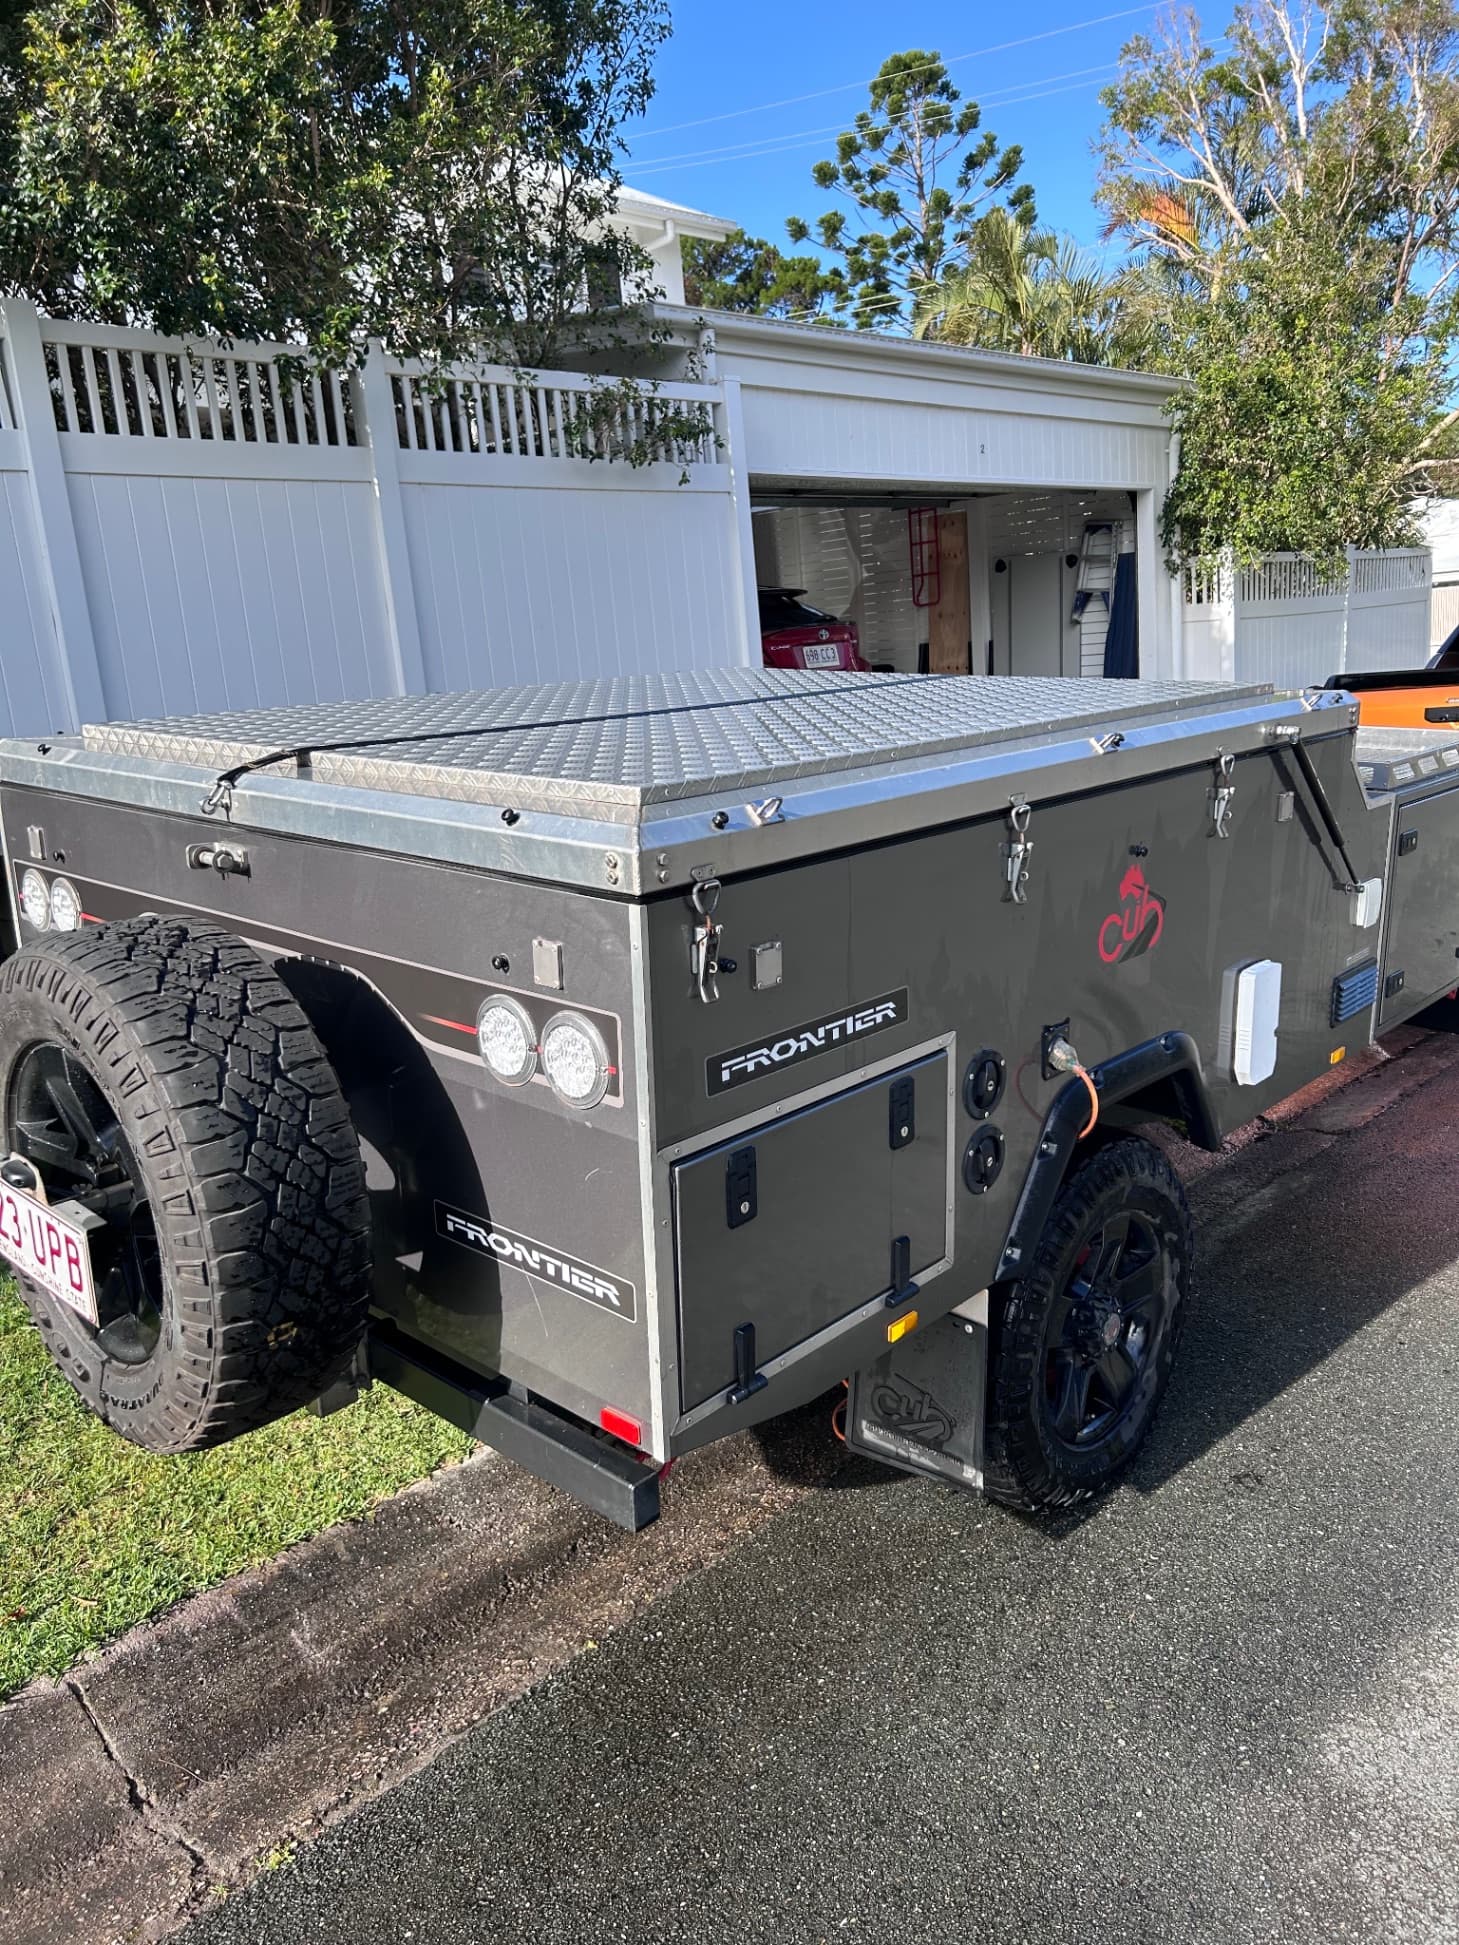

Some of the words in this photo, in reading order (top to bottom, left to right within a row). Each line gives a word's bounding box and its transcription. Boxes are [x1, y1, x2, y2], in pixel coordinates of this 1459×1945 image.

[979, 443, 986, 455] 2
[720, 1000, 898, 1083] FRONTIER
[28, 1209, 84, 1293] UPB
[446, 1213, 622, 1307] FRONTIER
